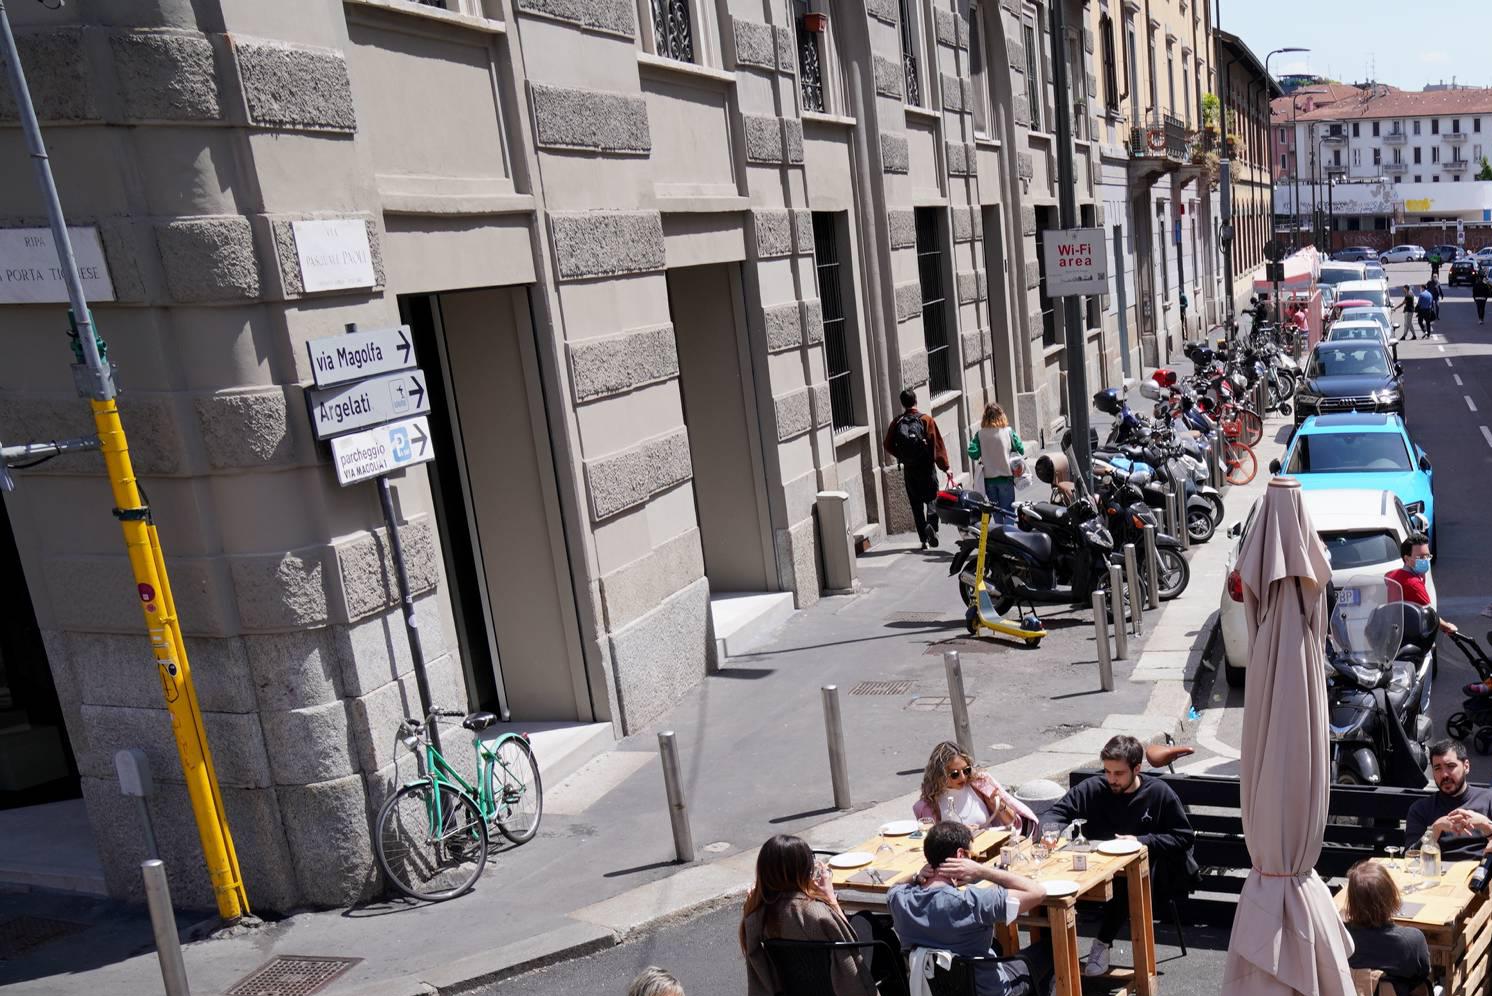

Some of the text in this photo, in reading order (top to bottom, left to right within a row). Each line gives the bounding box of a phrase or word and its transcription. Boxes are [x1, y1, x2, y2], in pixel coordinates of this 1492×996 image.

[24, 236, 46, 248] RIPA
[1057, 243, 1092, 256] Wi-Fi
[1058, 257, 1092, 267] area
[6, 267, 44, 282] PORTA
[316, 342, 383, 372] via Magolfa
[320, 392, 371, 423] Argelati
[340, 441, 386, 468] parcheggio
[343, 467, 356, 480] VIA
